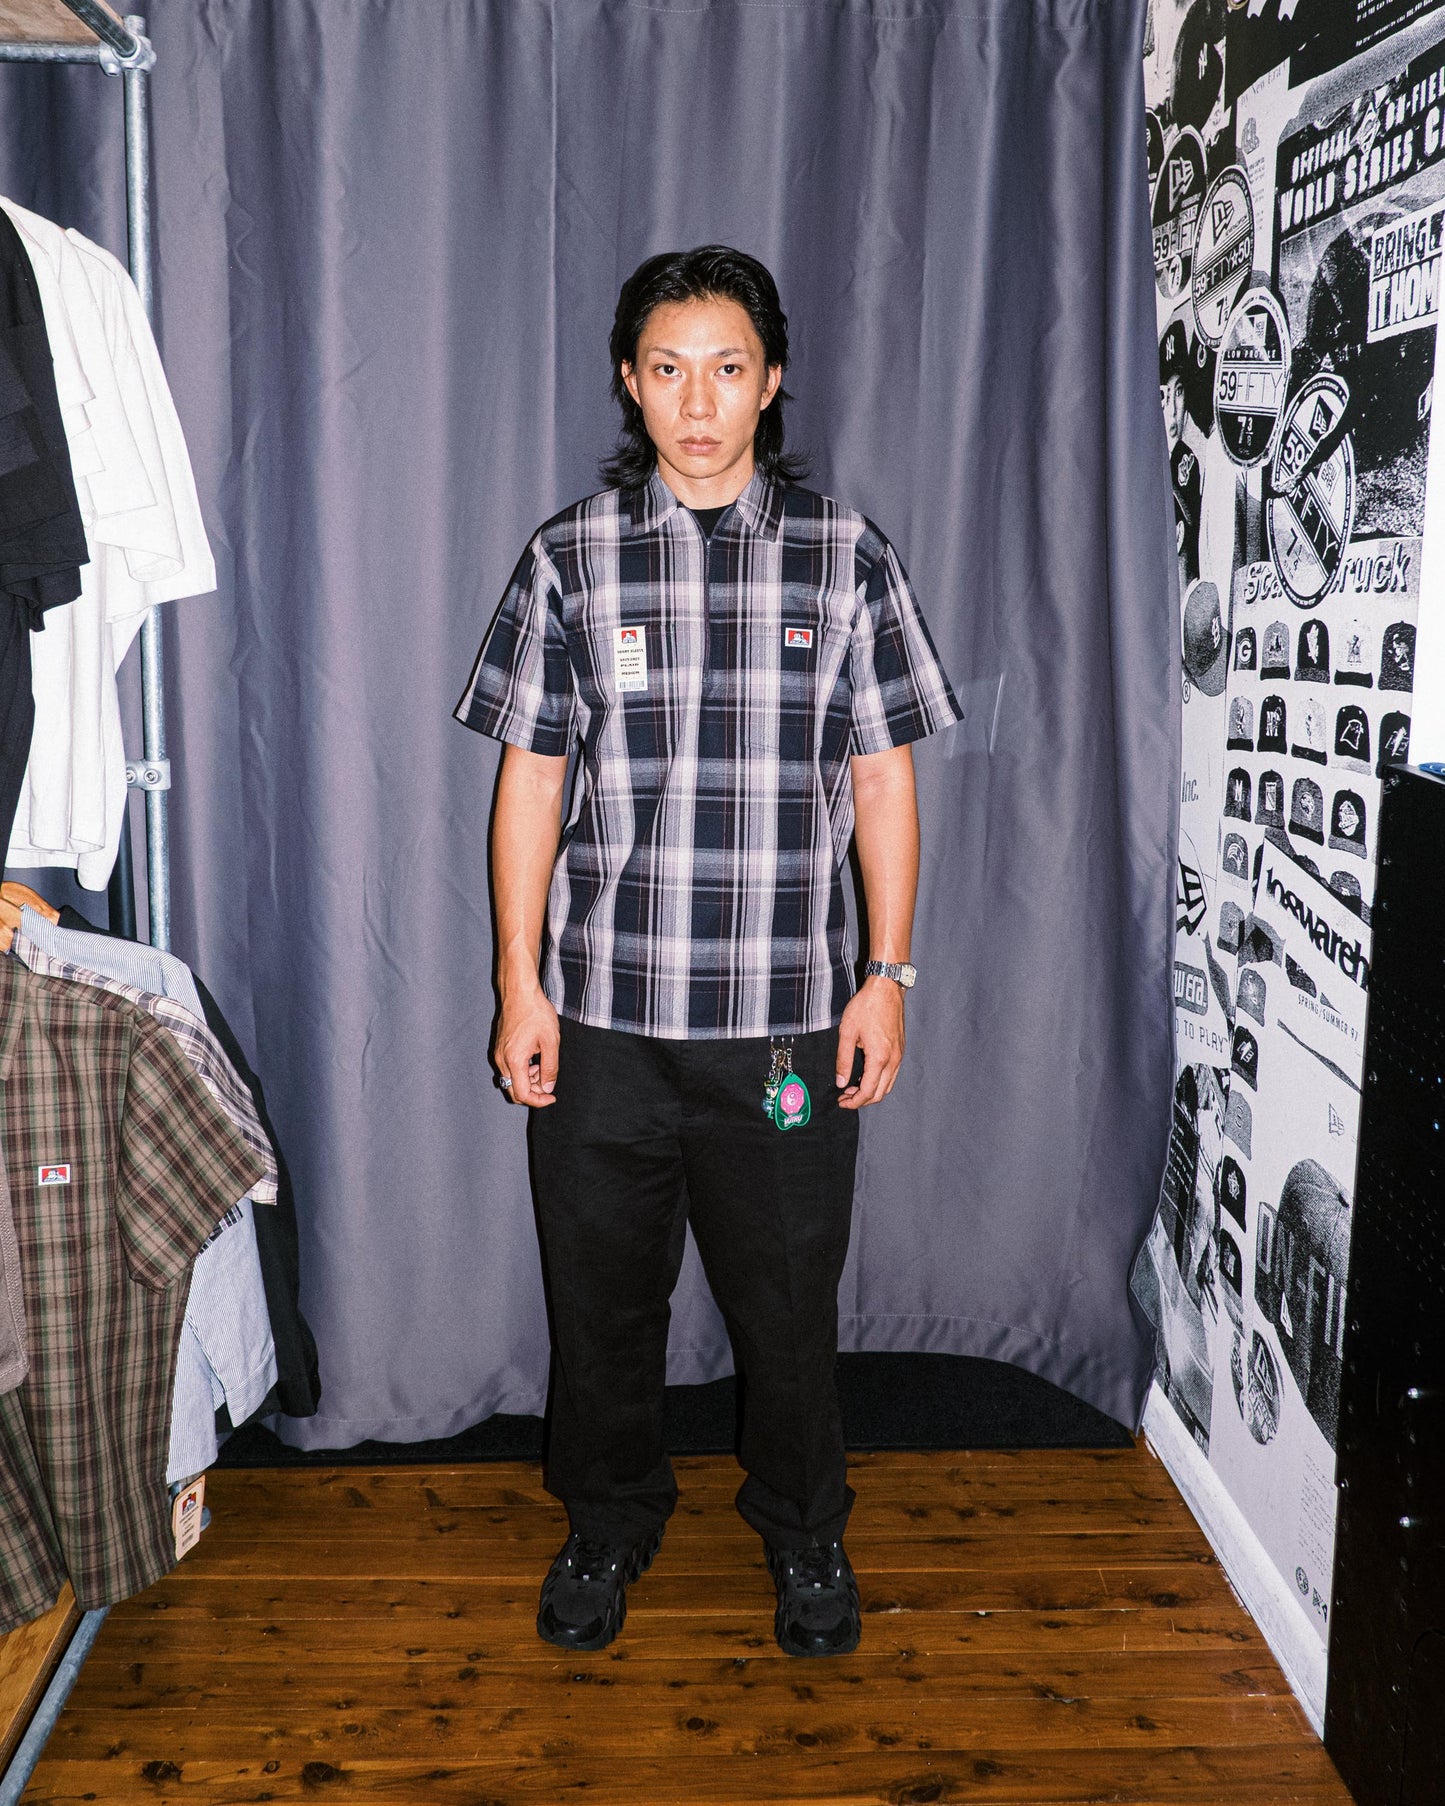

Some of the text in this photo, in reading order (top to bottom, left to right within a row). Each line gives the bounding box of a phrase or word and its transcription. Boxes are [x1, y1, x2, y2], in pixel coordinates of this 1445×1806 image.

[1291, 126, 1351, 184] OFFICIAL
[1280, 170, 1336, 233] WORLD
[1343, 129, 1414, 200] SERIES
[1244, 349, 1276, 359] PROLE
[1182, 772, 1199, 802] Inc.
[1184, 1019, 1195, 1040] TO
